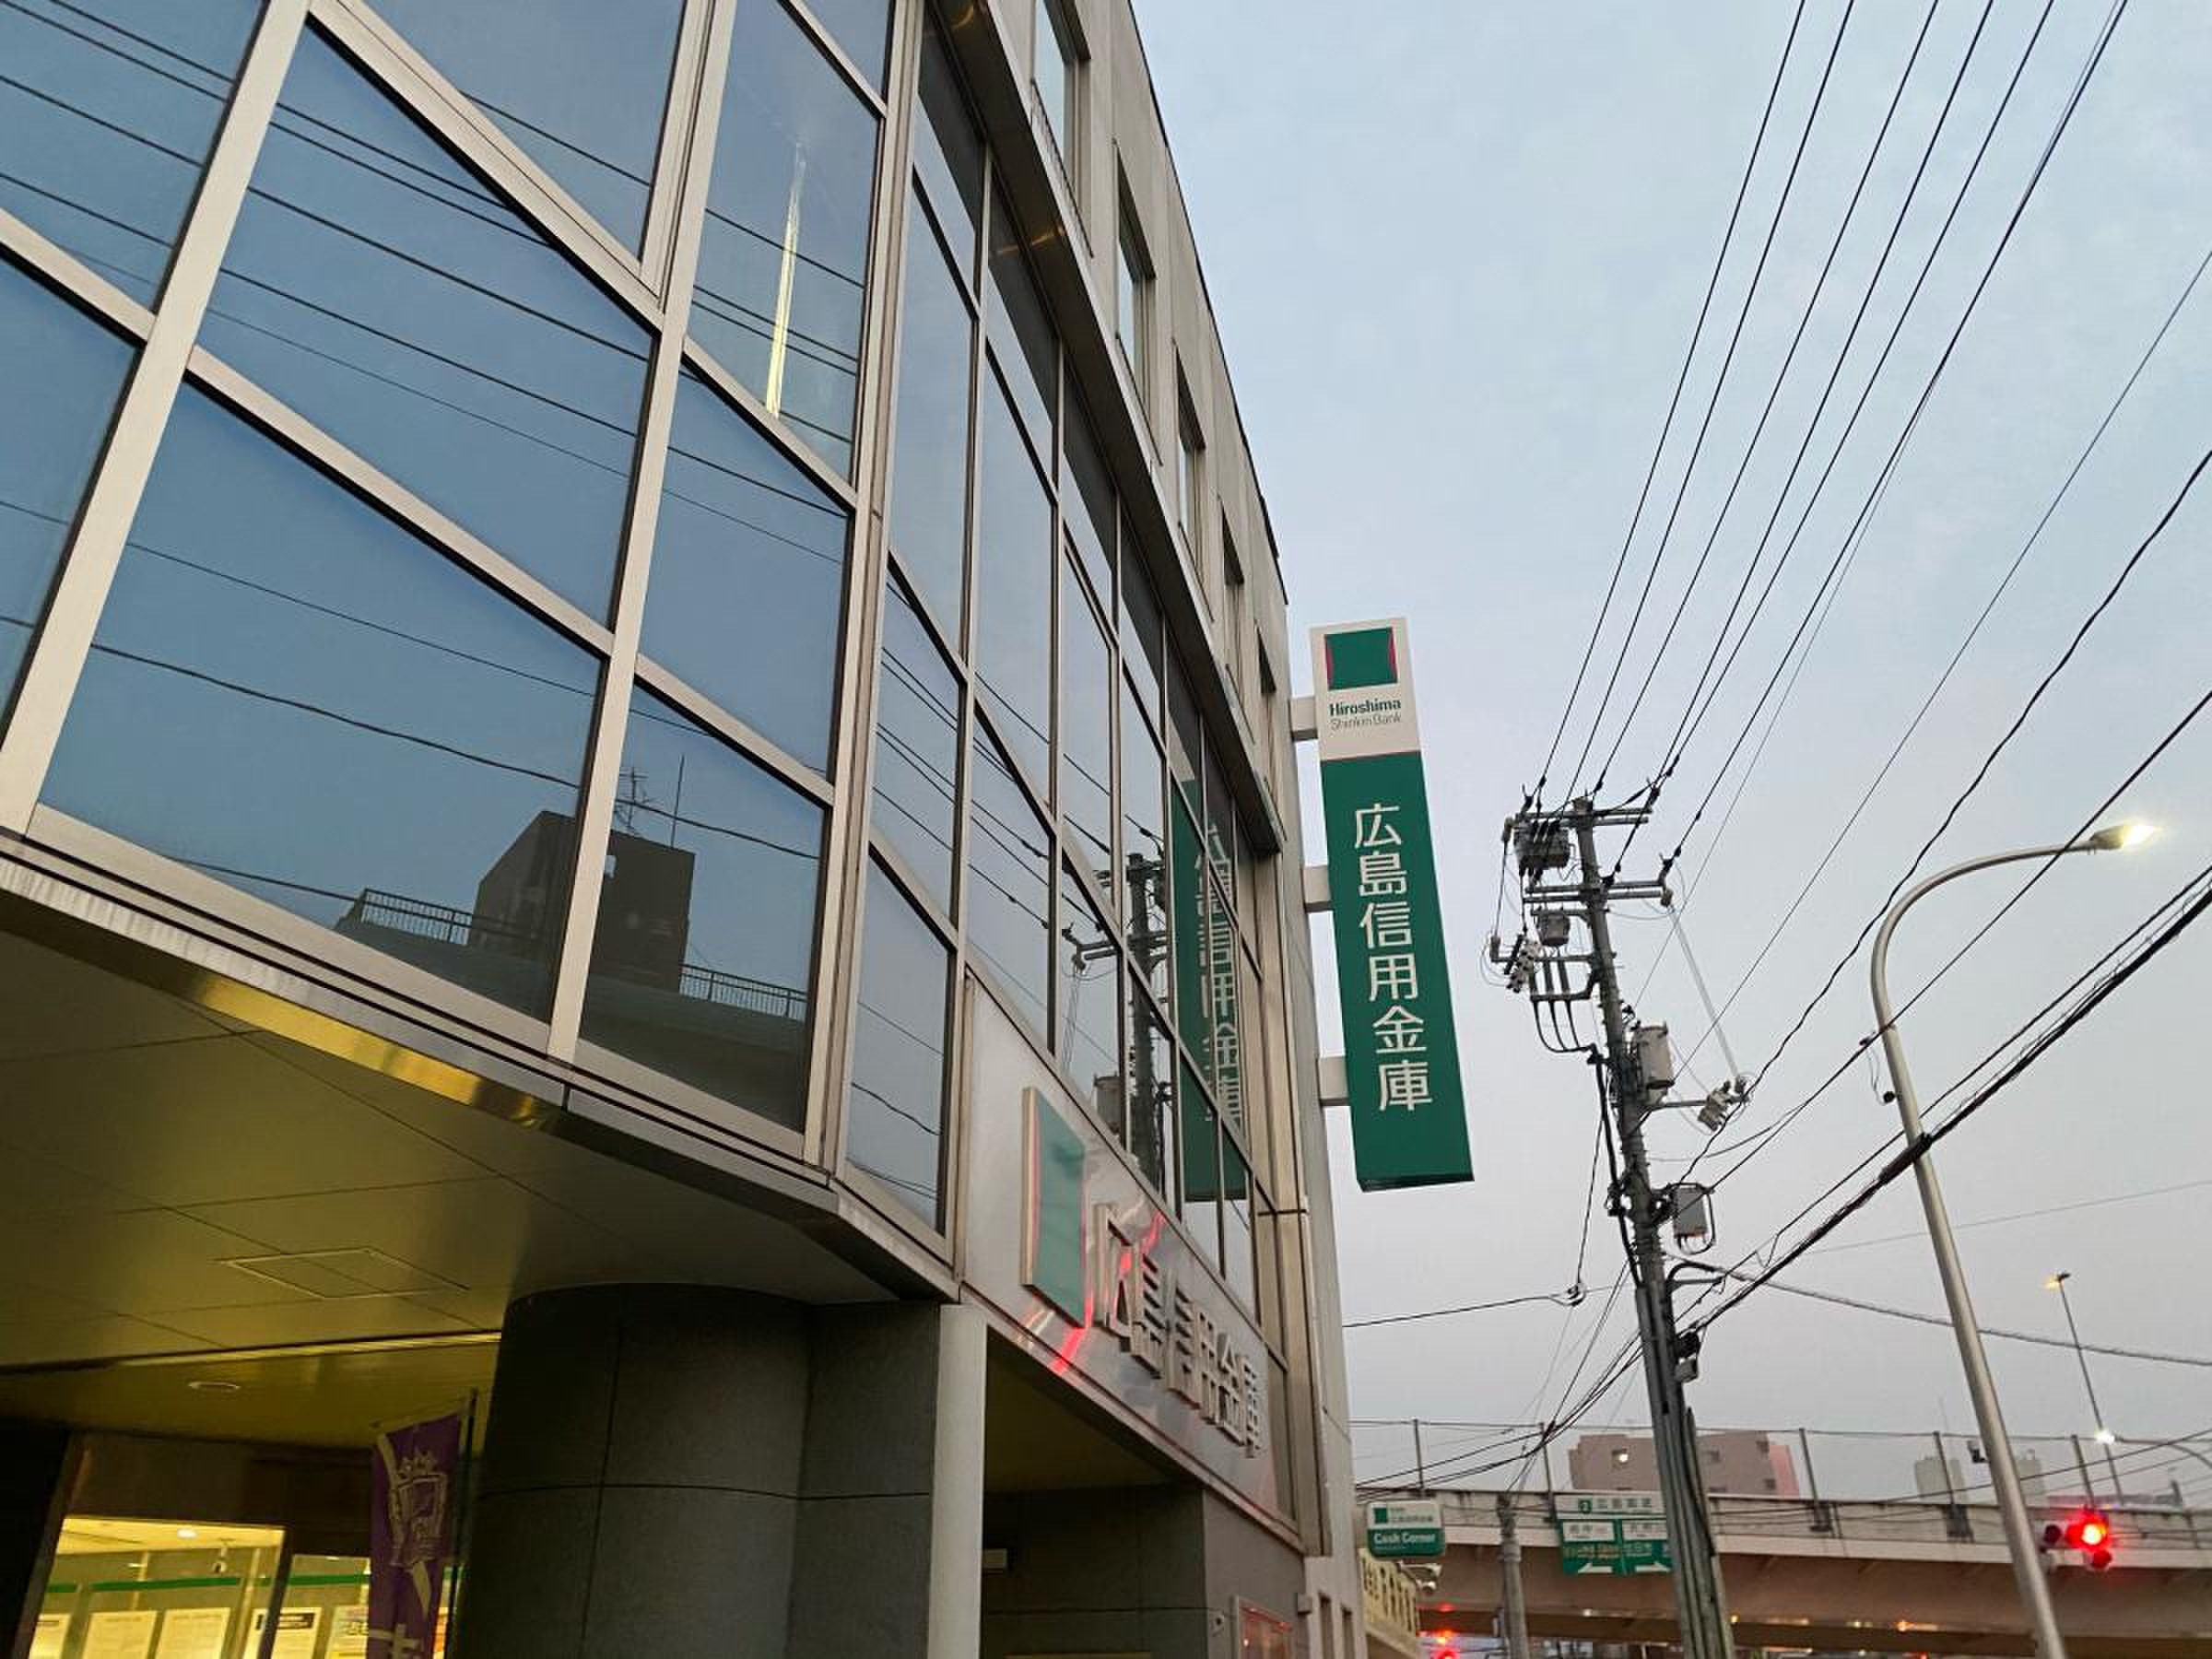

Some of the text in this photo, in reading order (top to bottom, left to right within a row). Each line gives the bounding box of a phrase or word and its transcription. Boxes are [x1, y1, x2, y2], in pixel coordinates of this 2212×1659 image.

[1329, 699, 1401, 716] Hiroshima
[1354, 803, 1433, 1112] 広島信用金庫
[1373, 1532, 1436, 1544] Cash Corner
